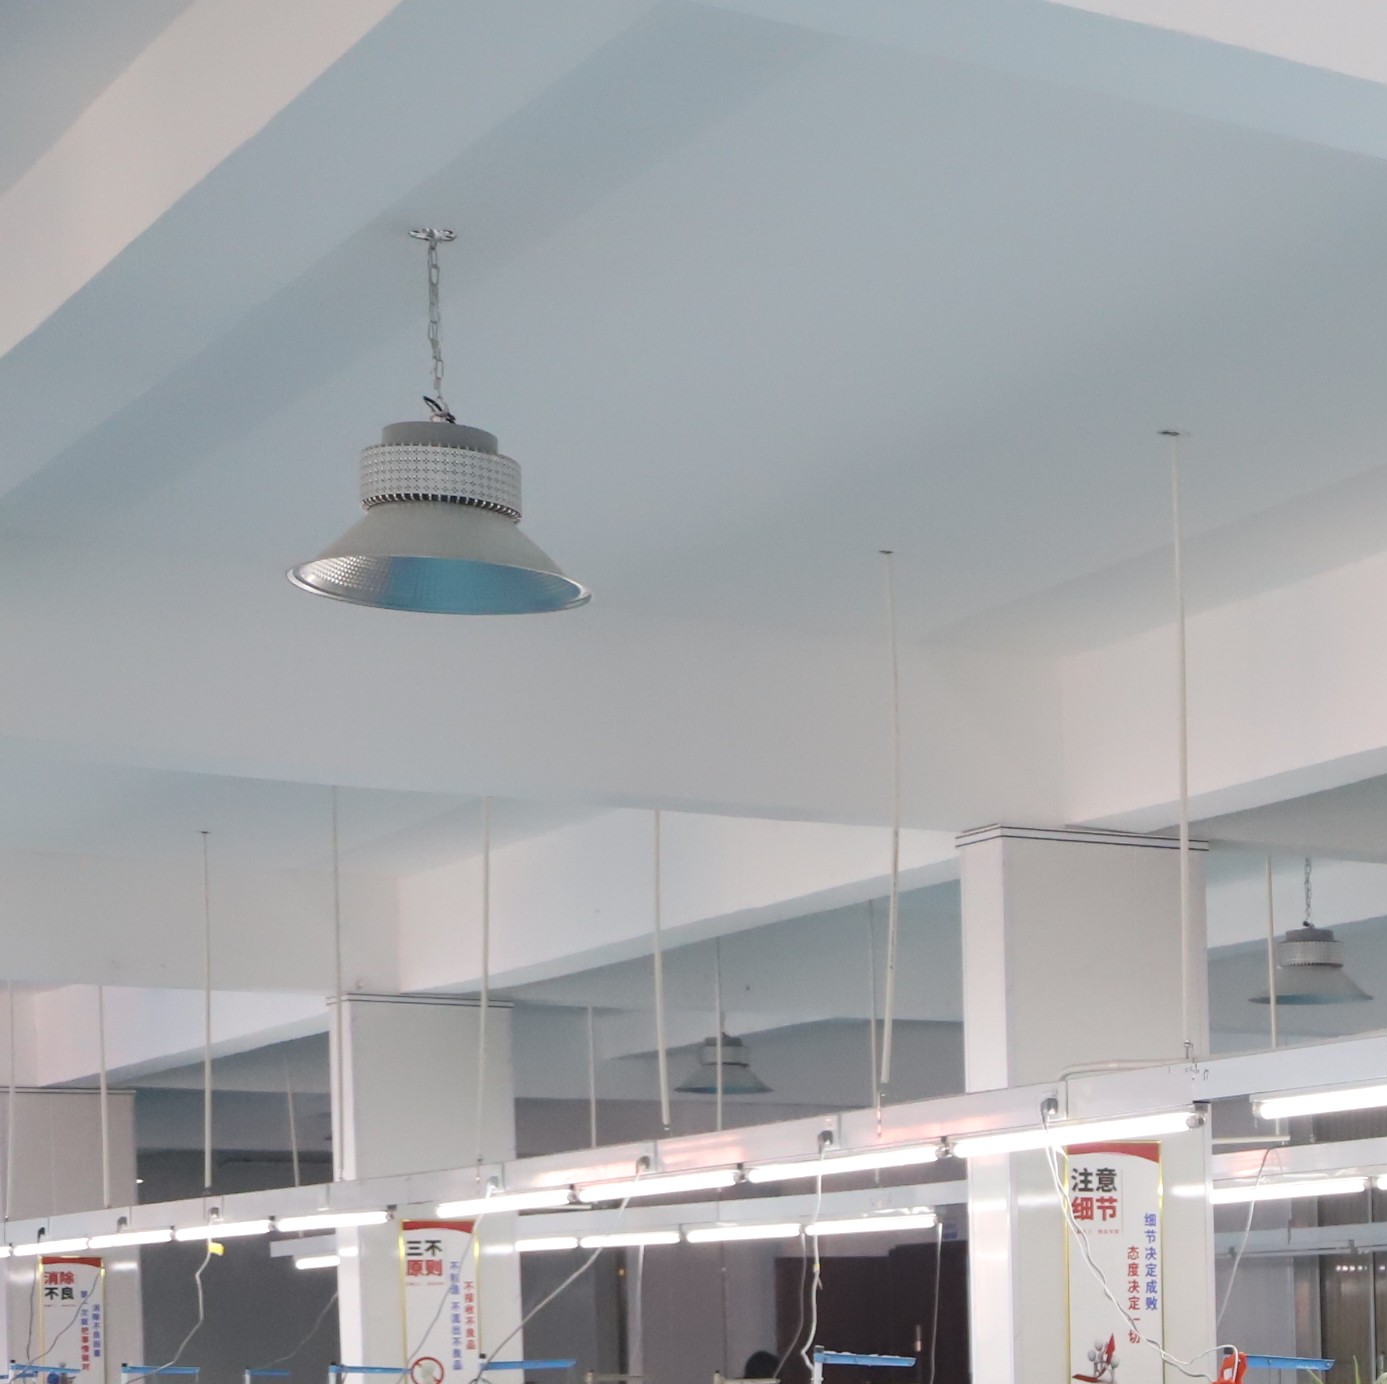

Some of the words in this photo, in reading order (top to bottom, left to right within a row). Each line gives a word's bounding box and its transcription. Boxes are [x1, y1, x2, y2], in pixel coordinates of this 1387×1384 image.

[1071, 1167, 1117, 1193] 注意
[1071, 1196, 1118, 1222] 细节
[406, 1240, 442, 1256] 三不
[407, 1259, 443, 1276] 原则
[1144, 1213, 1158, 1311] 细节决定成败
[44, 1271, 74, 1285] 消除
[44, 1287, 74, 1300] 不良
[1127, 1246, 1141, 1344] 态度决定一切
